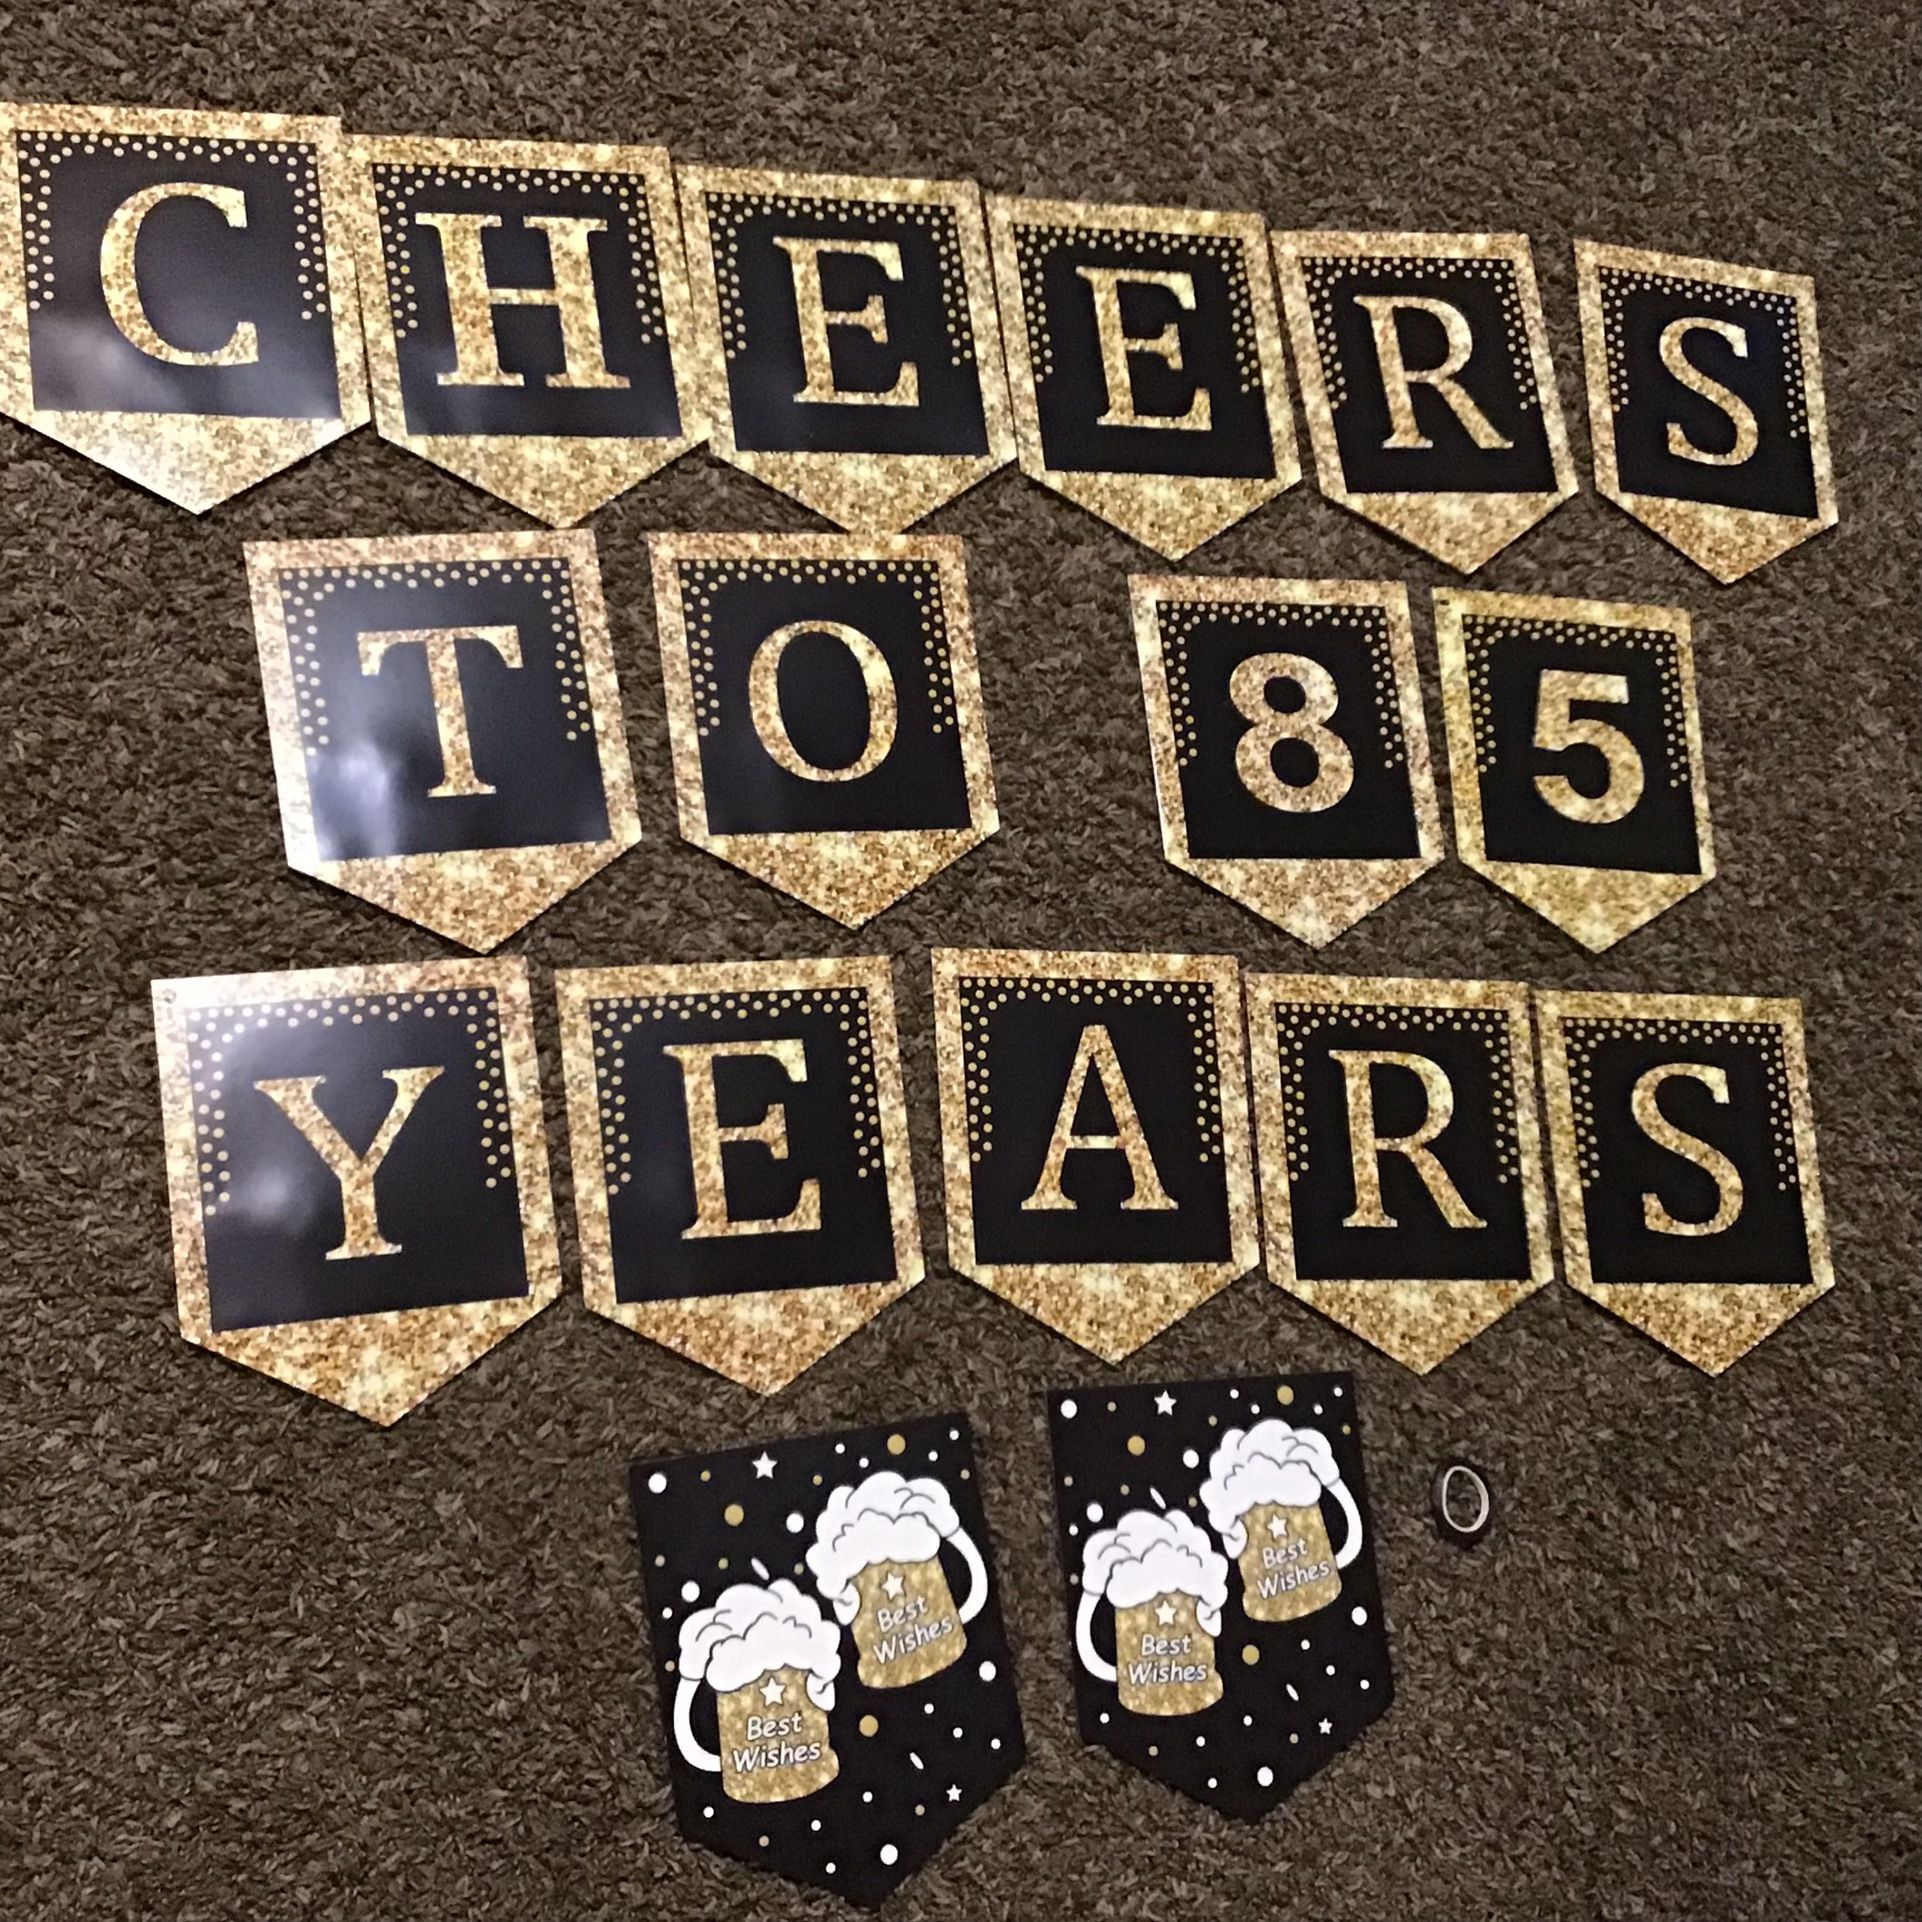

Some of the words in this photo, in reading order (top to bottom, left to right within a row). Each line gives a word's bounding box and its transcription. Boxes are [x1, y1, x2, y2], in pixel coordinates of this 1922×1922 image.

[99, 180, 1760, 467] CHEERS
[356, 618, 899, 800] TO
[1227, 650, 1646, 827] 85
[252, 1023, 1746, 1264] YEARS
[1261, 1540, 1309, 1570] Best
[1256, 1560, 1331, 1600] Wishes
[876, 1594, 929, 1634] Best
[872, 1616, 954, 1665] Wishes
[1140, 1633, 1192, 1656] Best
[1127, 1661, 1208, 1686] Wishes
[745, 1713, 803, 1742] Best
[731, 1740, 822, 1774] Wishes
